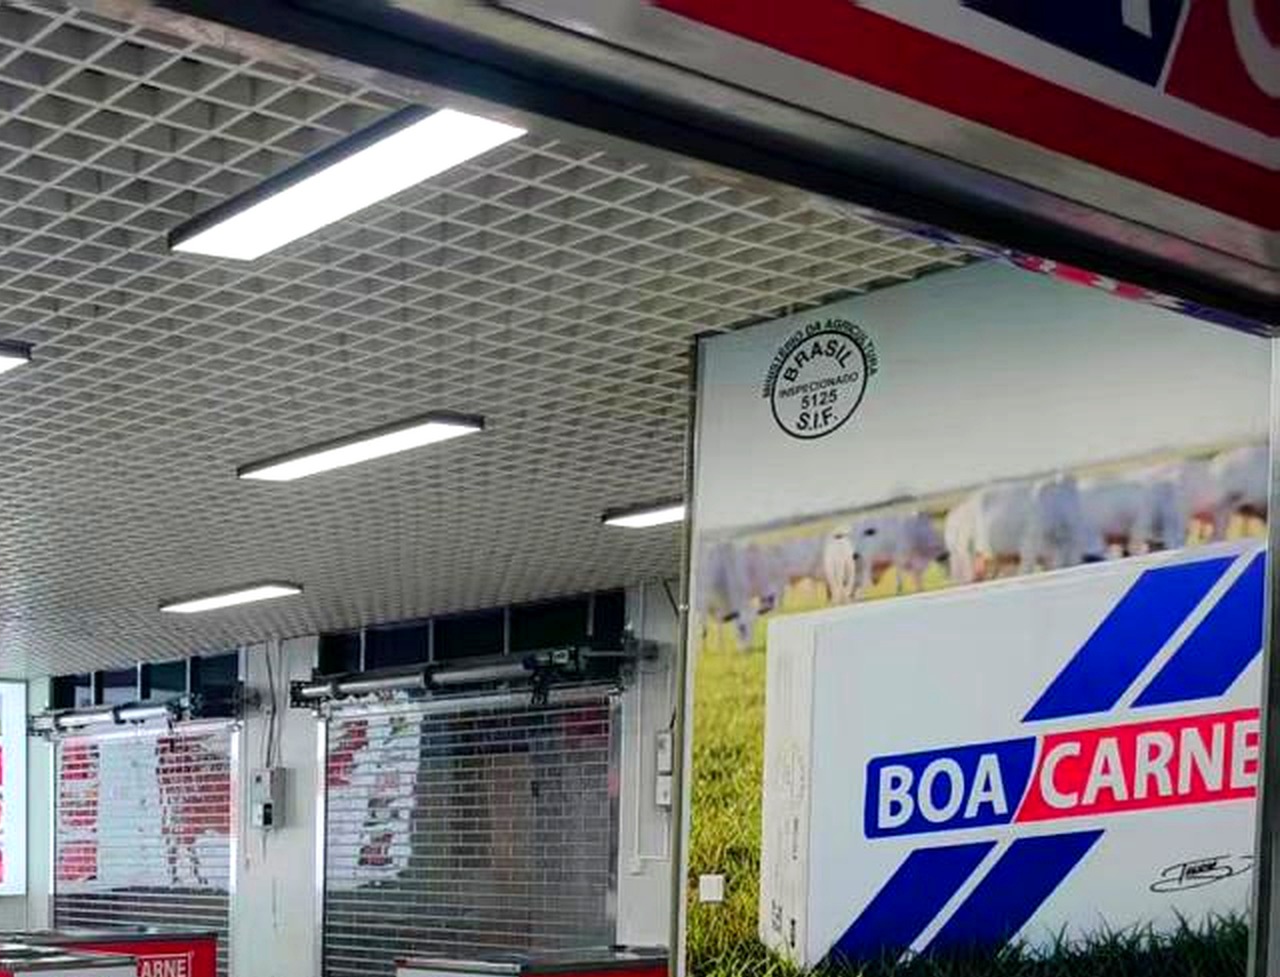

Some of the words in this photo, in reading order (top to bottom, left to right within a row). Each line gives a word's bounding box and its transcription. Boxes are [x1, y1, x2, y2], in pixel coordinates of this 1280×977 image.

[783, 339, 852, 382] BRASIL
[779, 371, 859, 398] INSPECIONADO
[801, 388, 838, 409] 5125
[796, 406, 839, 431] S.I.F.
[877, 753, 1009, 829] BOA
[1039, 719, 1260, 810] CARNE
